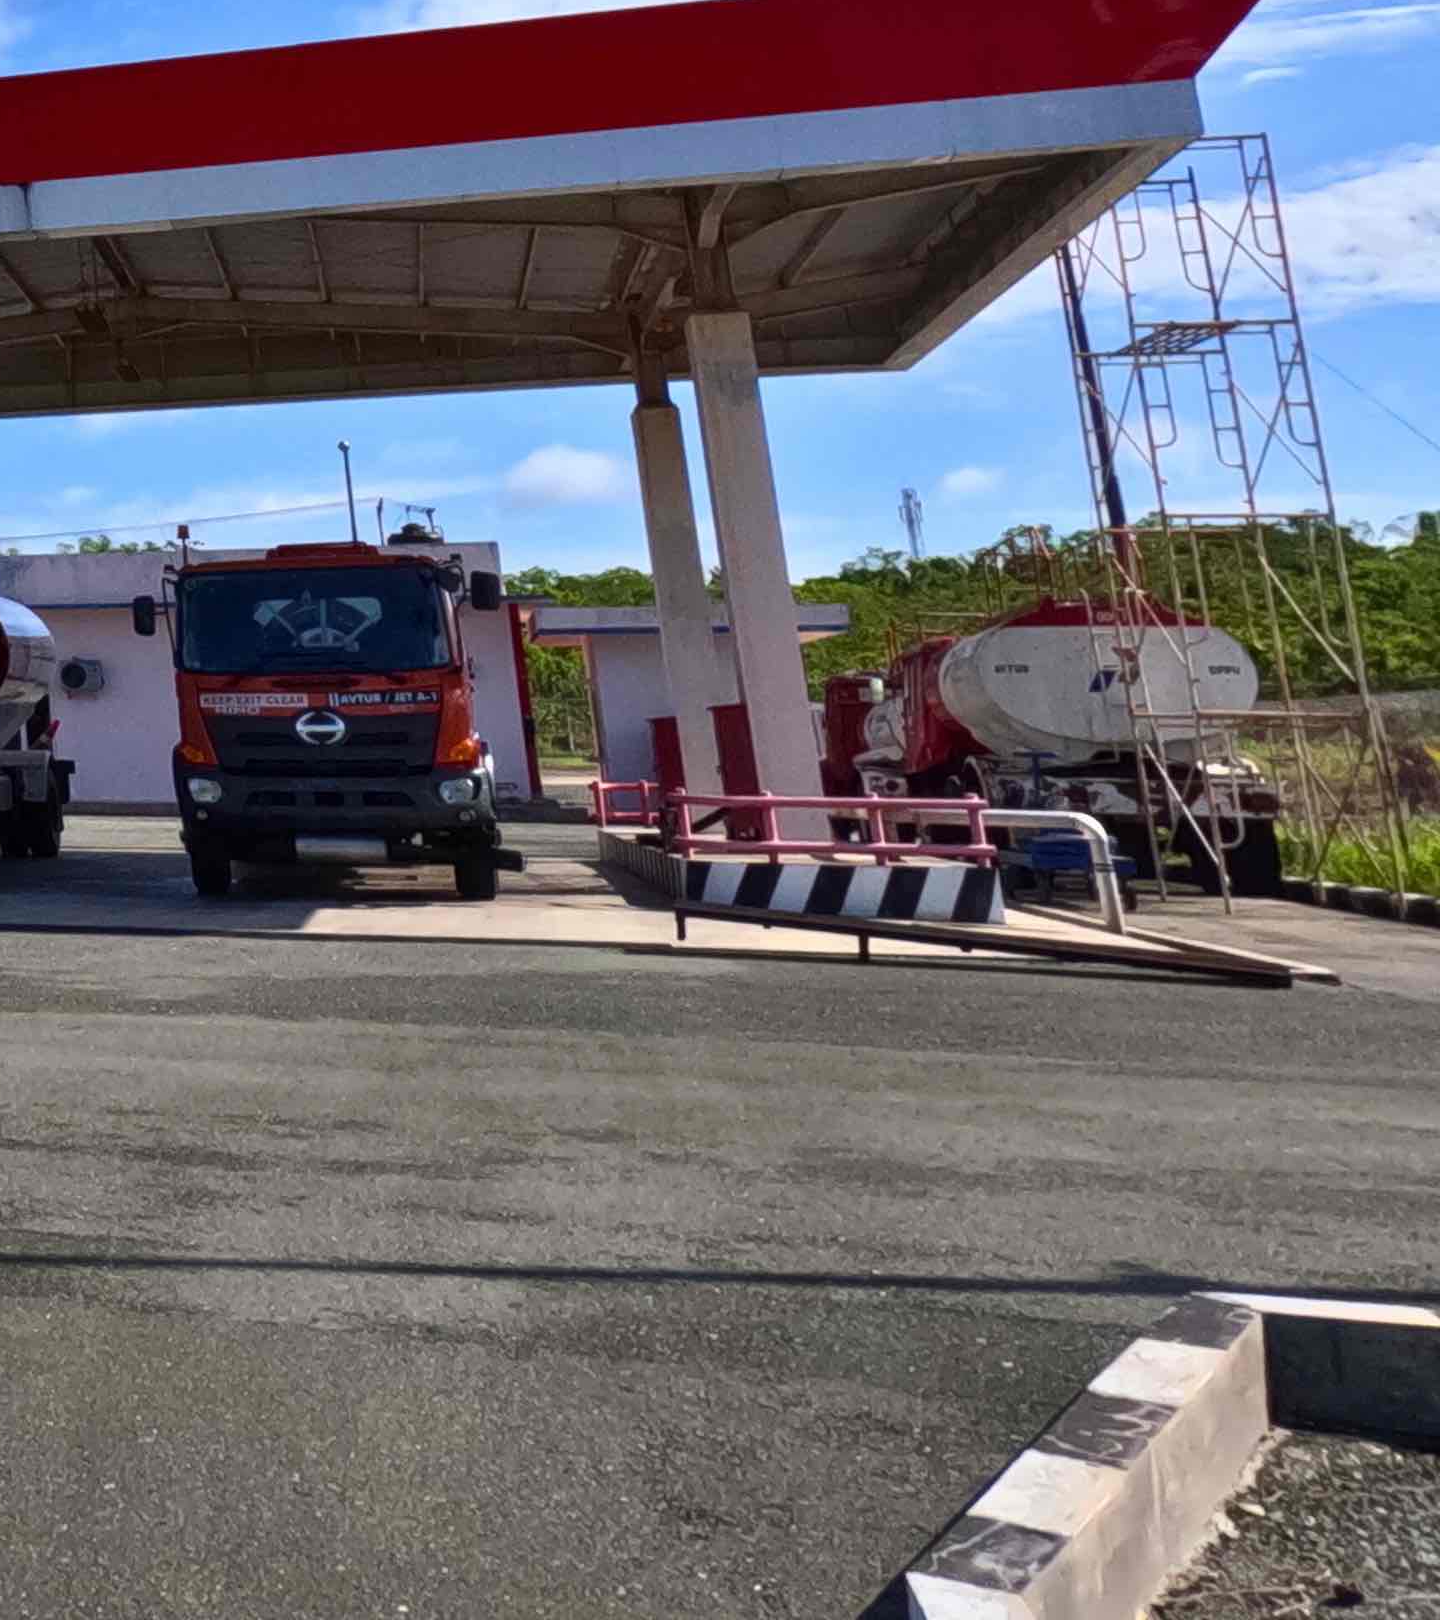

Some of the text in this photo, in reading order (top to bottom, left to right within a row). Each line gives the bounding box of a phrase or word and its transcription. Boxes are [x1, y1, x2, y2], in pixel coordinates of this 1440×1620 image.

[203, 695, 304, 706] KEEP EXIT CLEAR
[341, 692, 381, 703] AVTUR
[395, 691, 414, 702] JET
[417, 691, 437, 701] A-1
